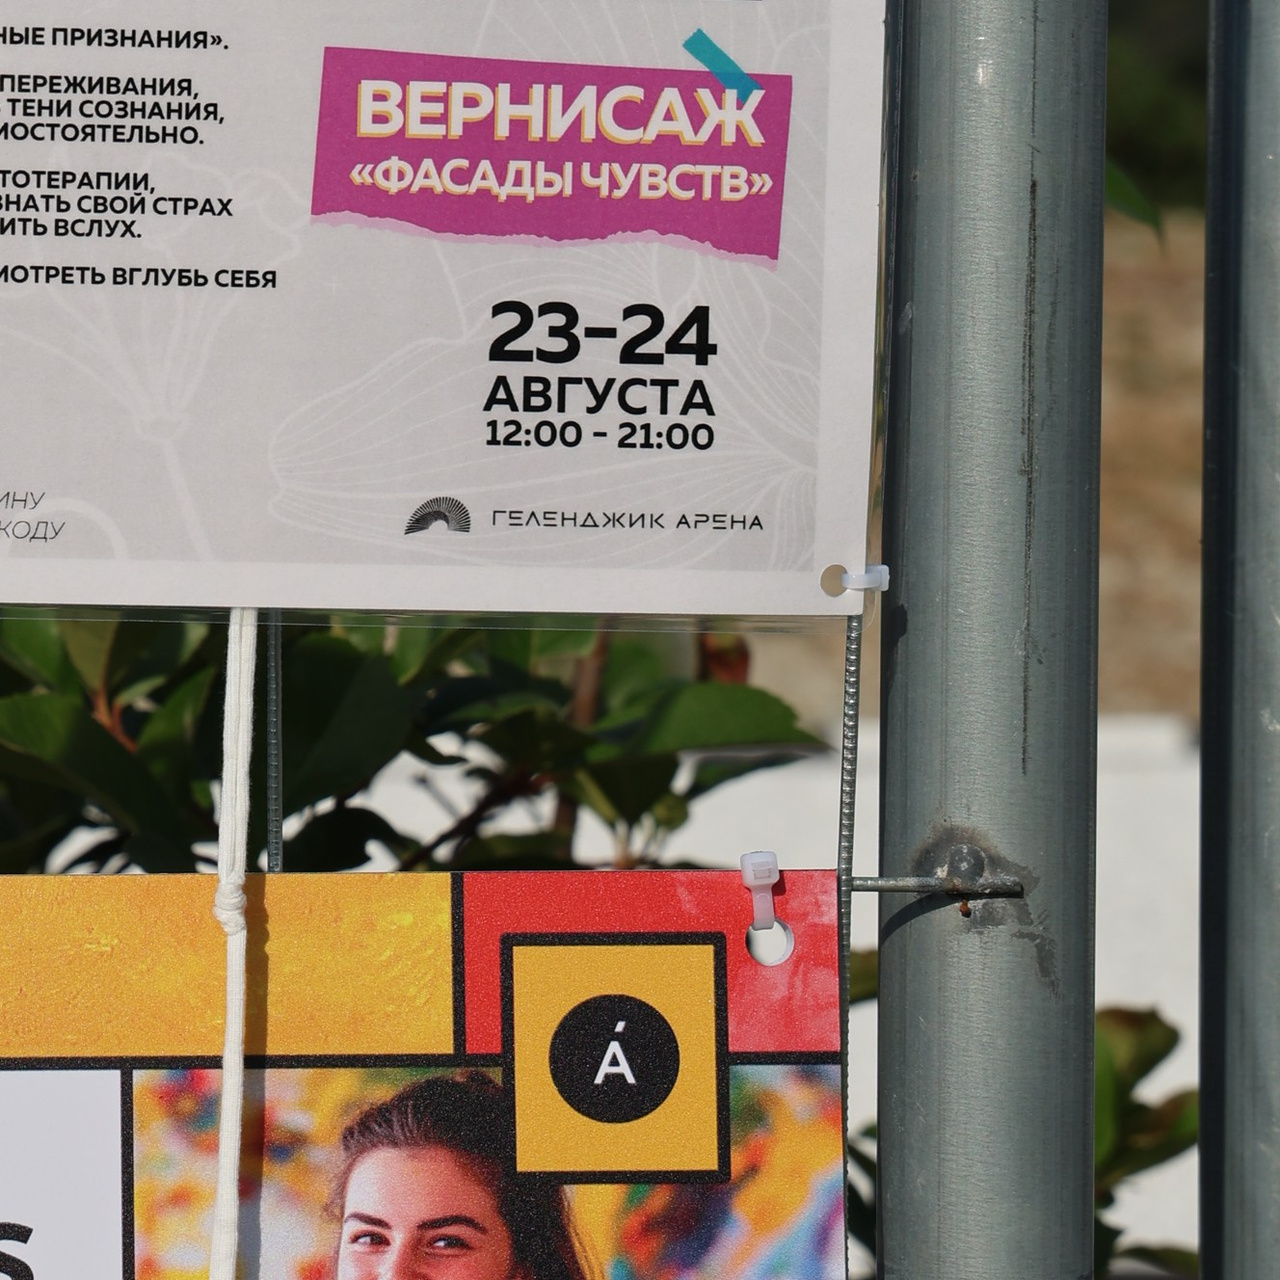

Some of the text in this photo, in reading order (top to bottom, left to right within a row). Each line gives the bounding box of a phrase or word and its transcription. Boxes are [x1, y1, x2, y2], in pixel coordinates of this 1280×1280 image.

[51, 27, 229, 50] ПРИЗНАНИЯ».
[0, 74, 199, 100] ПЕРЕЖИВАНИЯ,
[6, 98, 72, 118] ТЕНИ
[78, 99, 225, 125] СОЗНАНИЯ,
[357, 79, 766, 147] ВЕРНИСАЖ
[350, 154, 774, 203] «ФАСАДЫ ЧУВСТВ»
[76, 192, 146, 215] СВОЙ
[152, 196, 233, 217] СТРАХ
[54, 218, 142, 238] ВСЛУХ.
[112, 267, 209, 287] ВГЛУБЬ
[214, 269, 277, 289] СЕБЯ
[483, 375, 717, 417] АВГУСТА
[486, 419, 583, 448] 12:00
[617, 421, 716, 451] 21:00
[491, 509, 765, 531] ГЕЛЕНДЖИК АРЕНА
